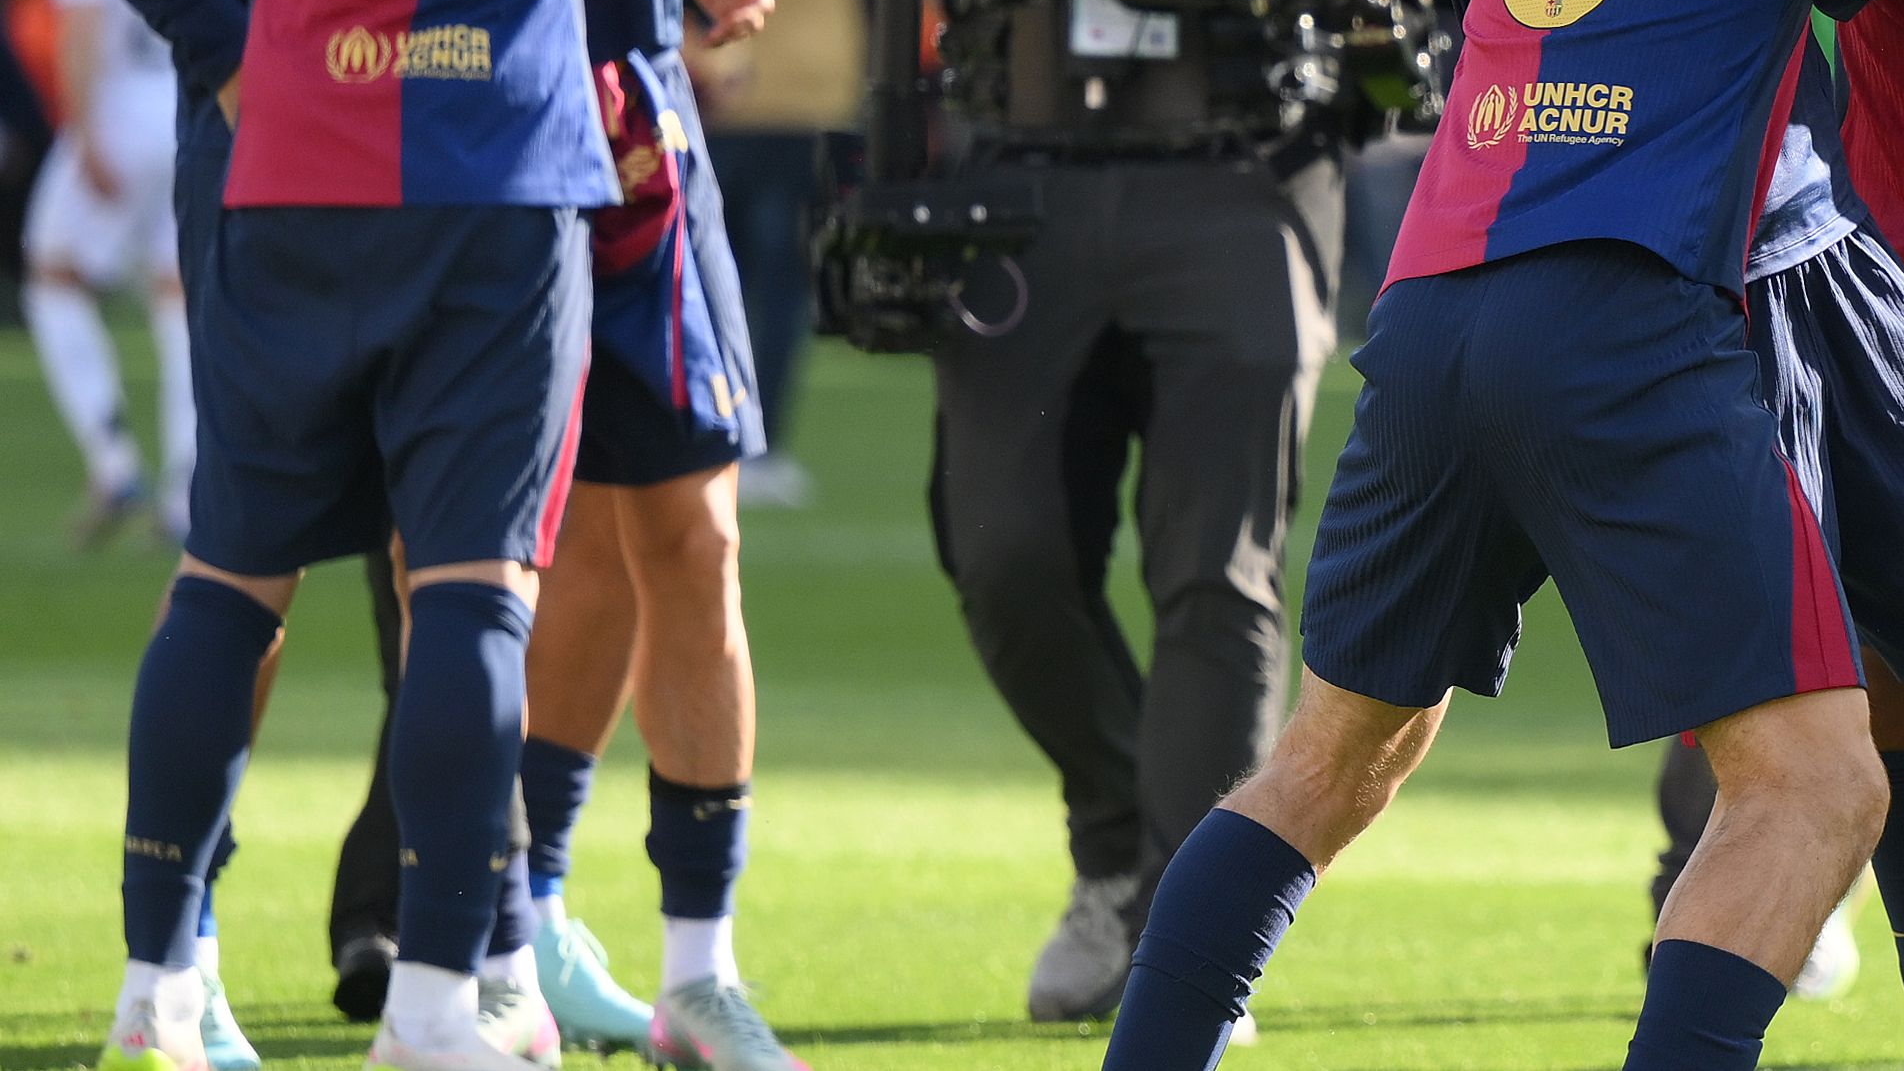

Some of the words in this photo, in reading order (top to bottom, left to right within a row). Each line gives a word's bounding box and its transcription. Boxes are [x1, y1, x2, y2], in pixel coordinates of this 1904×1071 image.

[1523, 81, 1634, 111] UNHCR
[1517, 107, 1629, 134] ACNUR
[1517, 134, 1533, 143] The
[1534, 134, 1549, 143] UN
[1549, 134, 1587, 146] Refugee
[1588, 135, 1625, 147] Agency
